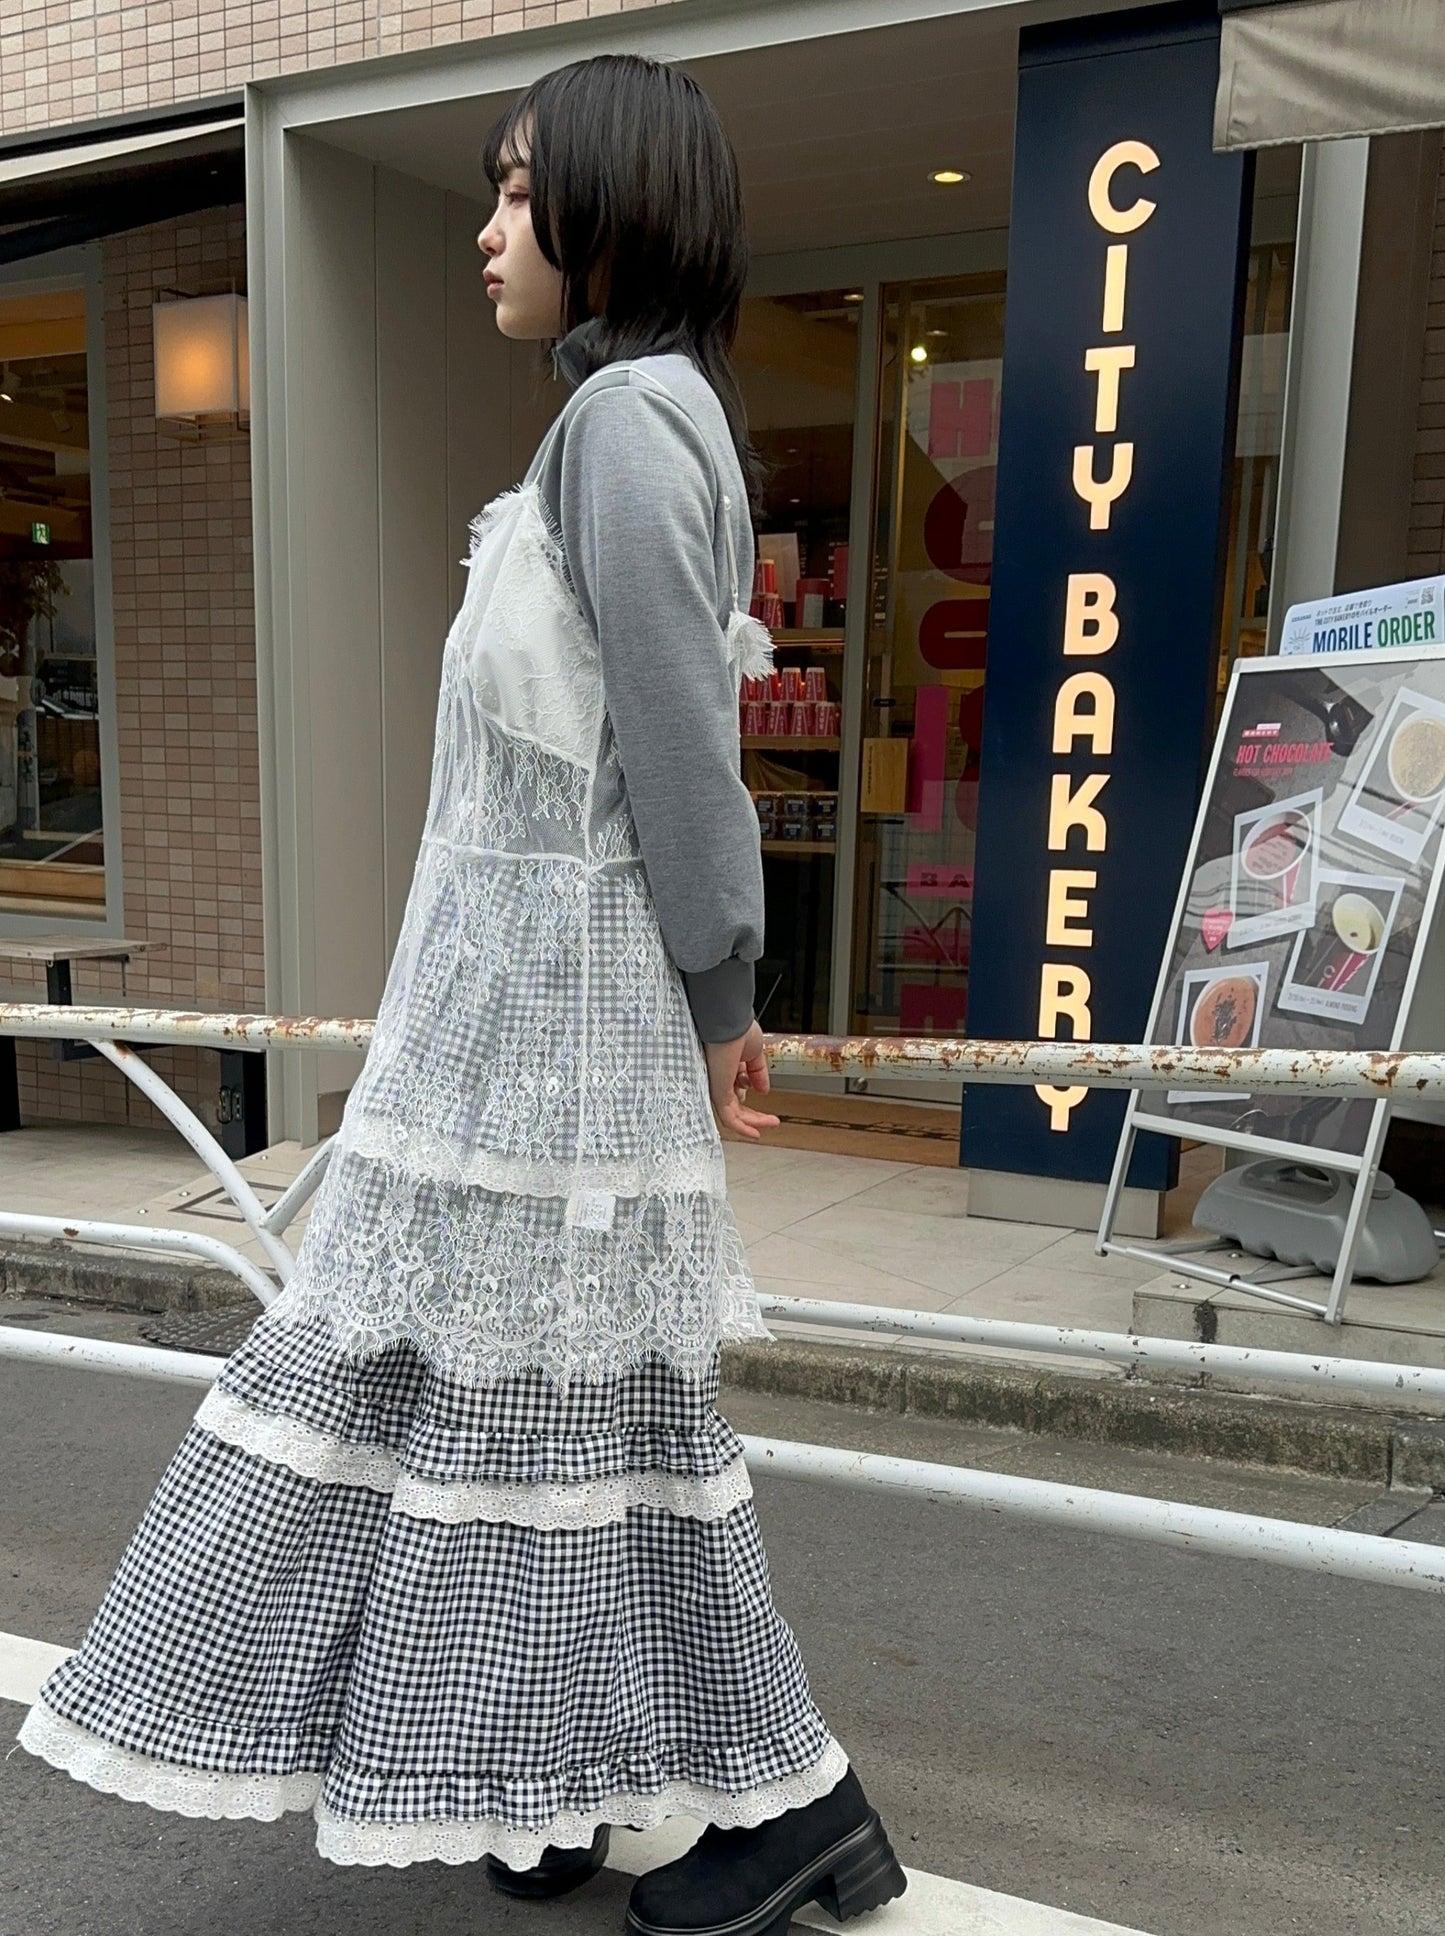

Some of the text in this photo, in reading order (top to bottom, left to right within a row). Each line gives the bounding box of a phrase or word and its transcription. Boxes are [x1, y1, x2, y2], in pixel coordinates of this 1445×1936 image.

[1035, 140, 1160, 1132] CITY BAKERY
[1312, 611, 1436, 653] MOBILE ORDER
[1236, 742, 1334, 764] HOT CHOCOLATE
